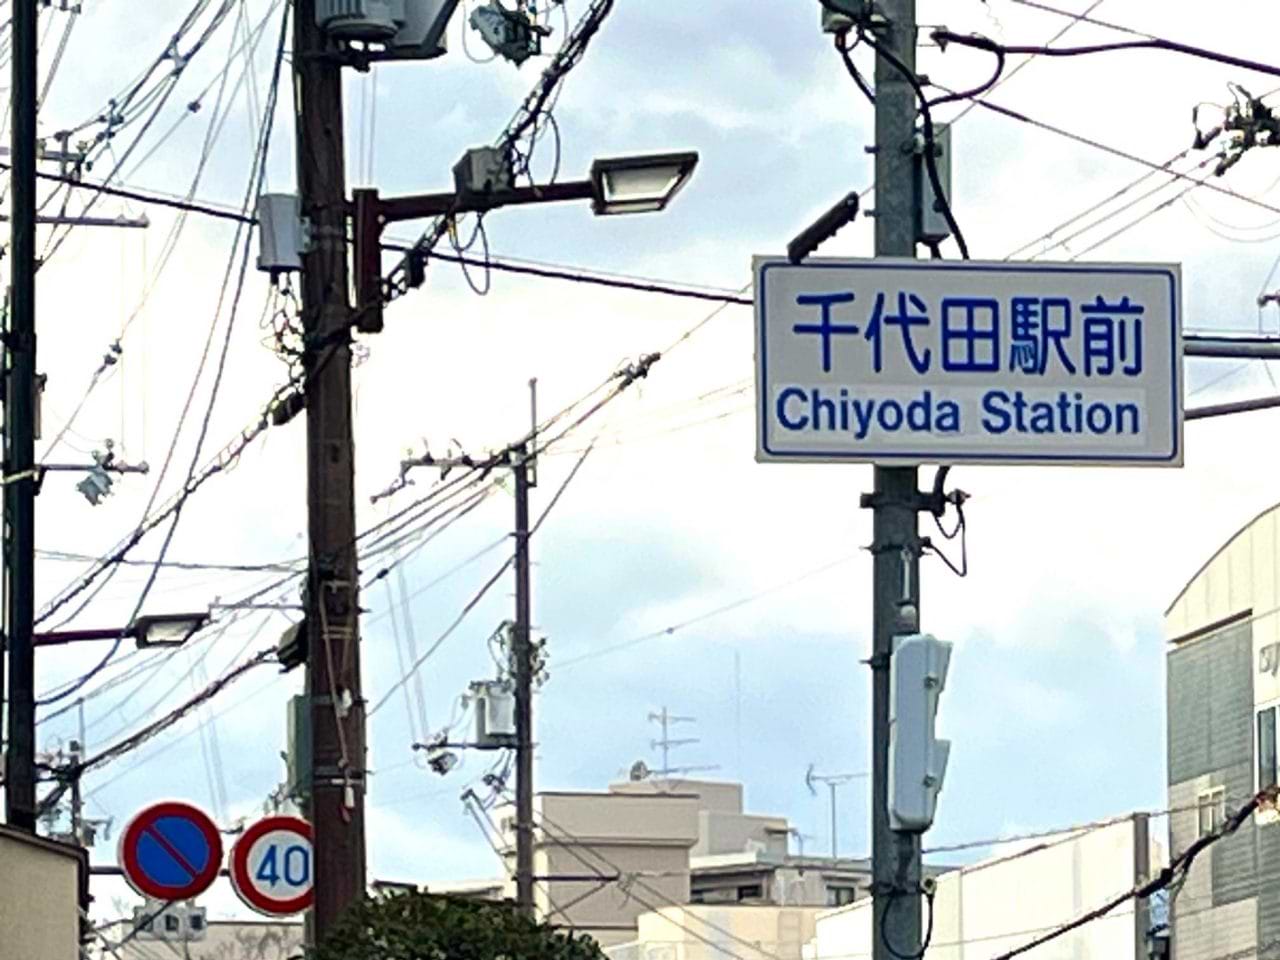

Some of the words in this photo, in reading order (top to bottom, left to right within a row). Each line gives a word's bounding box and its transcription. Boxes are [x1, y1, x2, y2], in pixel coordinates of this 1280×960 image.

[793, 291, 1145, 377] 千代田駅前
[776, 387, 960, 440] Chiyoda
[981, 392, 1140, 435] Station
[256, 844, 310, 888] 40
